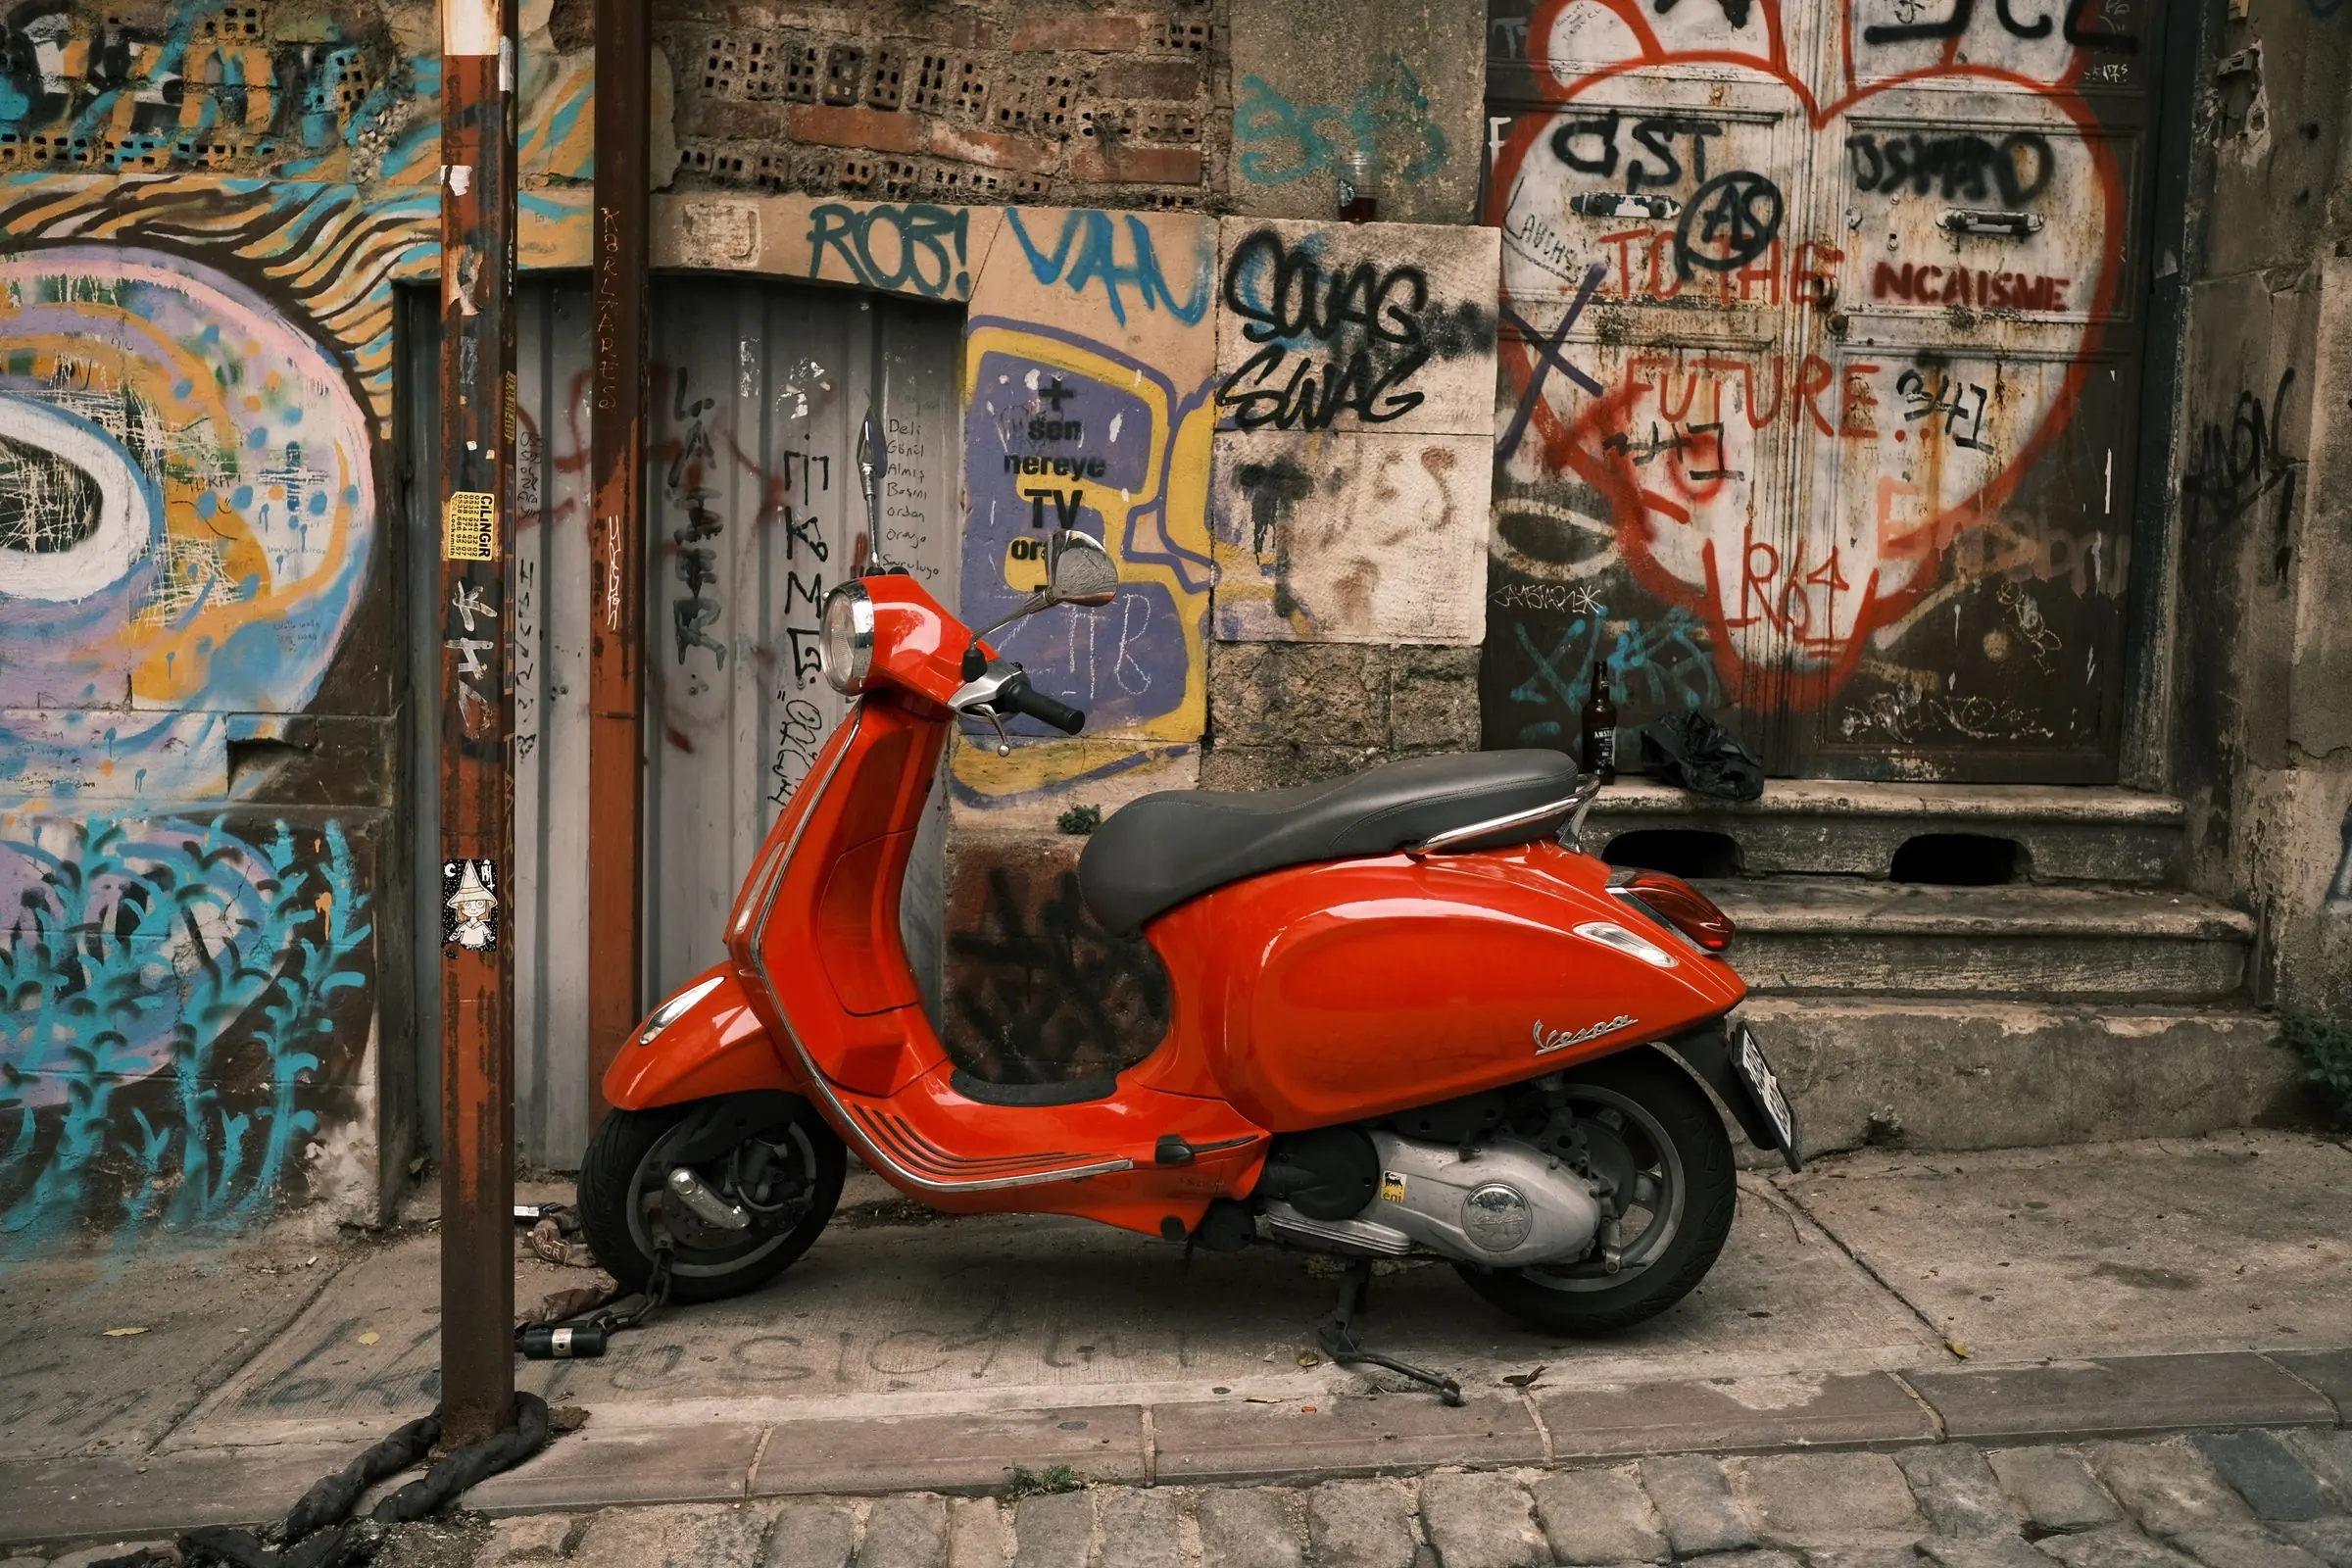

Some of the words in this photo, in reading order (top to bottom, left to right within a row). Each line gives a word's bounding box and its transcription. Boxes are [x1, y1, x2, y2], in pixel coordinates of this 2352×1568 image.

[1596, 226, 1684, 302] TO
[1216, 343, 1430, 429] SWAG
[889, 418, 921, 436] Deli
[1004, 454, 1106, 481] nereye
[1024, 488, 1084, 529] TV
[473, 535, 478, 544] 32
[456, 547, 461, 556] 57
[462, 547, 466, 556] 07
[466, 547, 471, 556] 57
[472, 548, 477, 557] 02
[1533, 1014, 1640, 1056] Vespa
